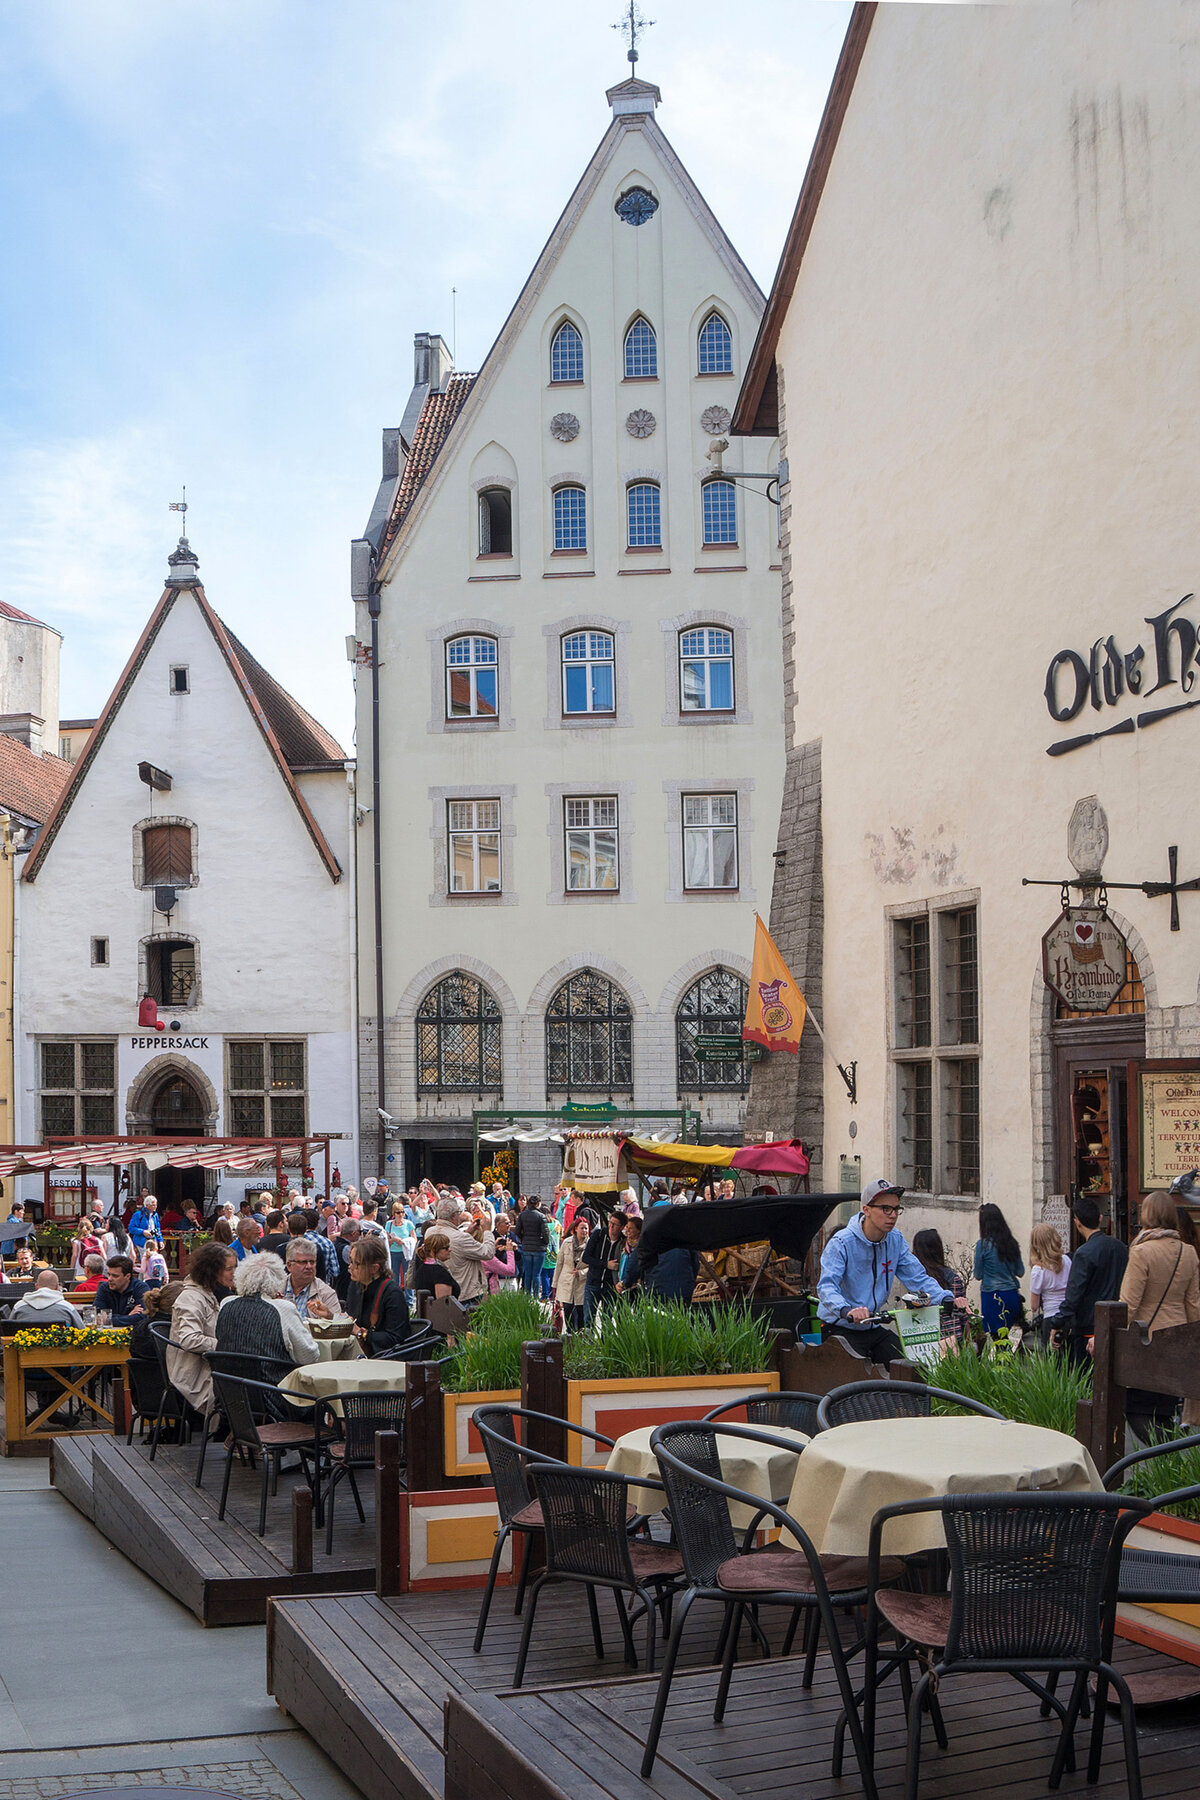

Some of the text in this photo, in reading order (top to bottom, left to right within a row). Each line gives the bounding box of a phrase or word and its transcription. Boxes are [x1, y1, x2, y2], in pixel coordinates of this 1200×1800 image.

[1044, 635, 1145, 722] Olde
[131, 1037, 209, 1049] PEPPERSACK
[1177, 1155, 1200, 1163] TERE
